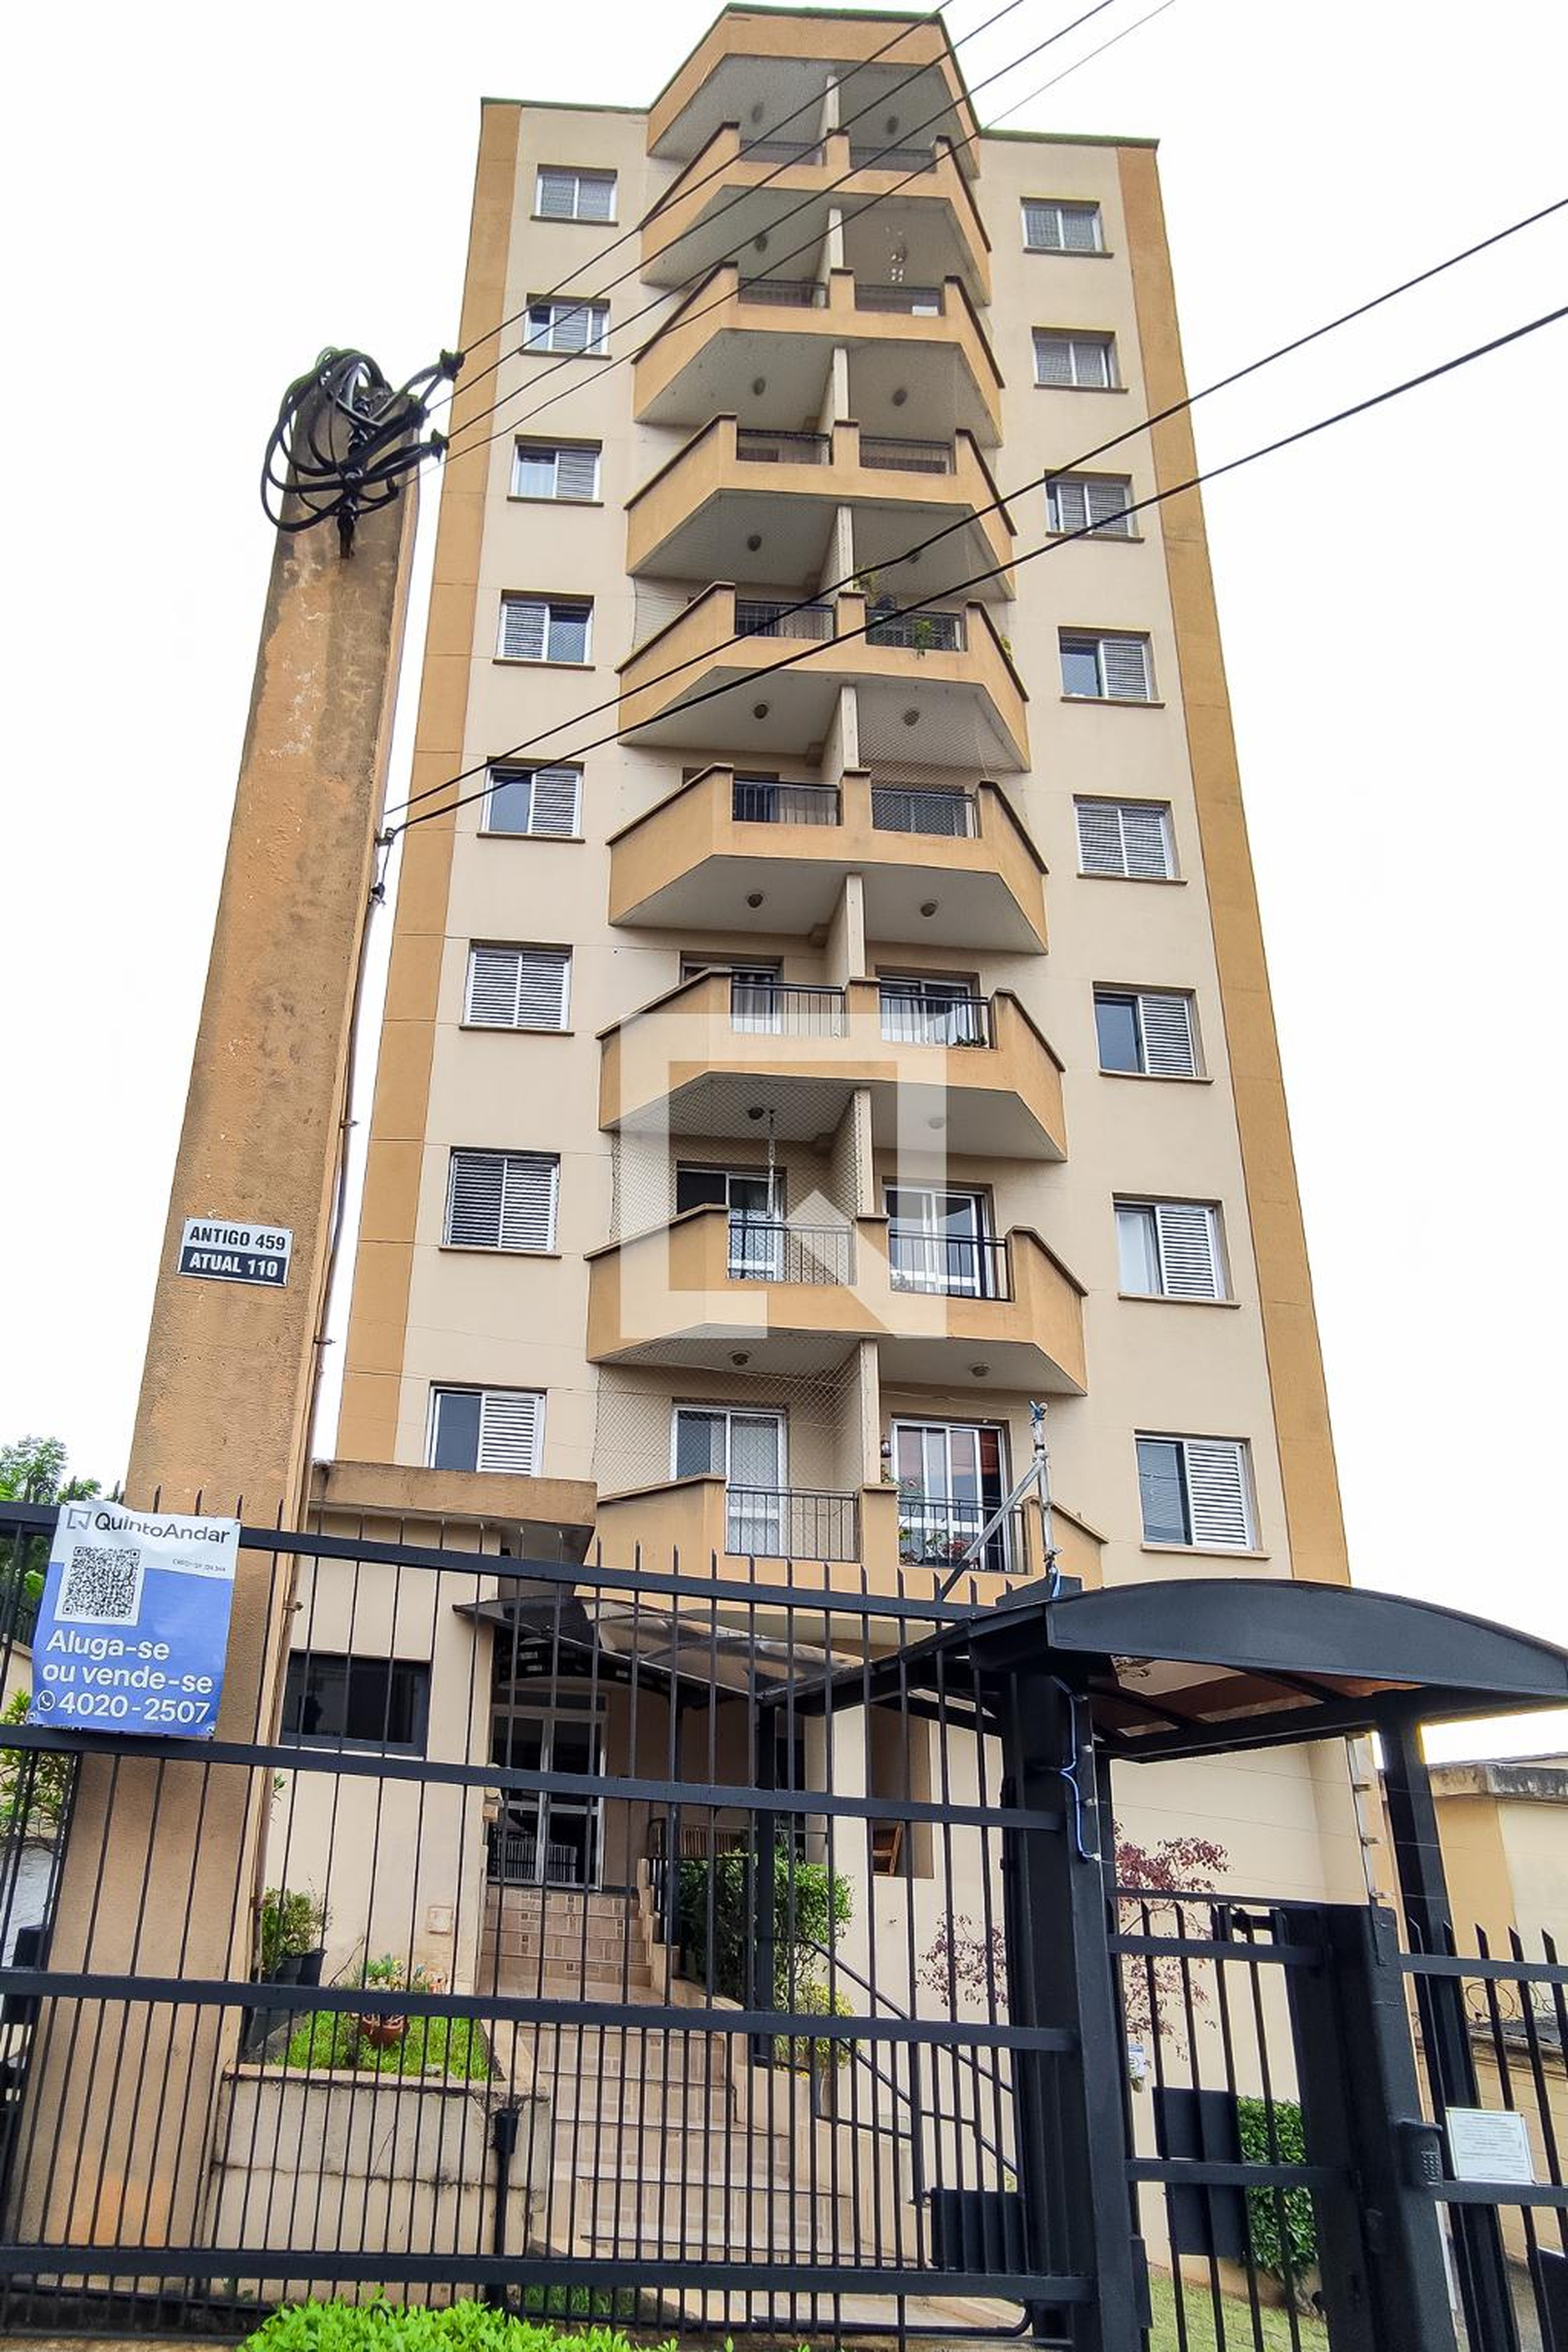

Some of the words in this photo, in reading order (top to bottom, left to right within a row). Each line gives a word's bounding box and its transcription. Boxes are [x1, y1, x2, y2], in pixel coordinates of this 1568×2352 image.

[190, 1226, 250, 1246] ANTIGO
[255, 1234, 285, 1250] 459
[189, 1252, 242, 1273] ATUAL
[247, 1259, 278, 1277] 110
[94, 1512, 230, 1544] QuintoAndar
[46, 1630, 170, 1661] Aluga-se
[42, 1664, 76, 1683] ou
[82, 1666, 213, 1694] vende-se
[58, 1691, 211, 1723] 4020-2507
